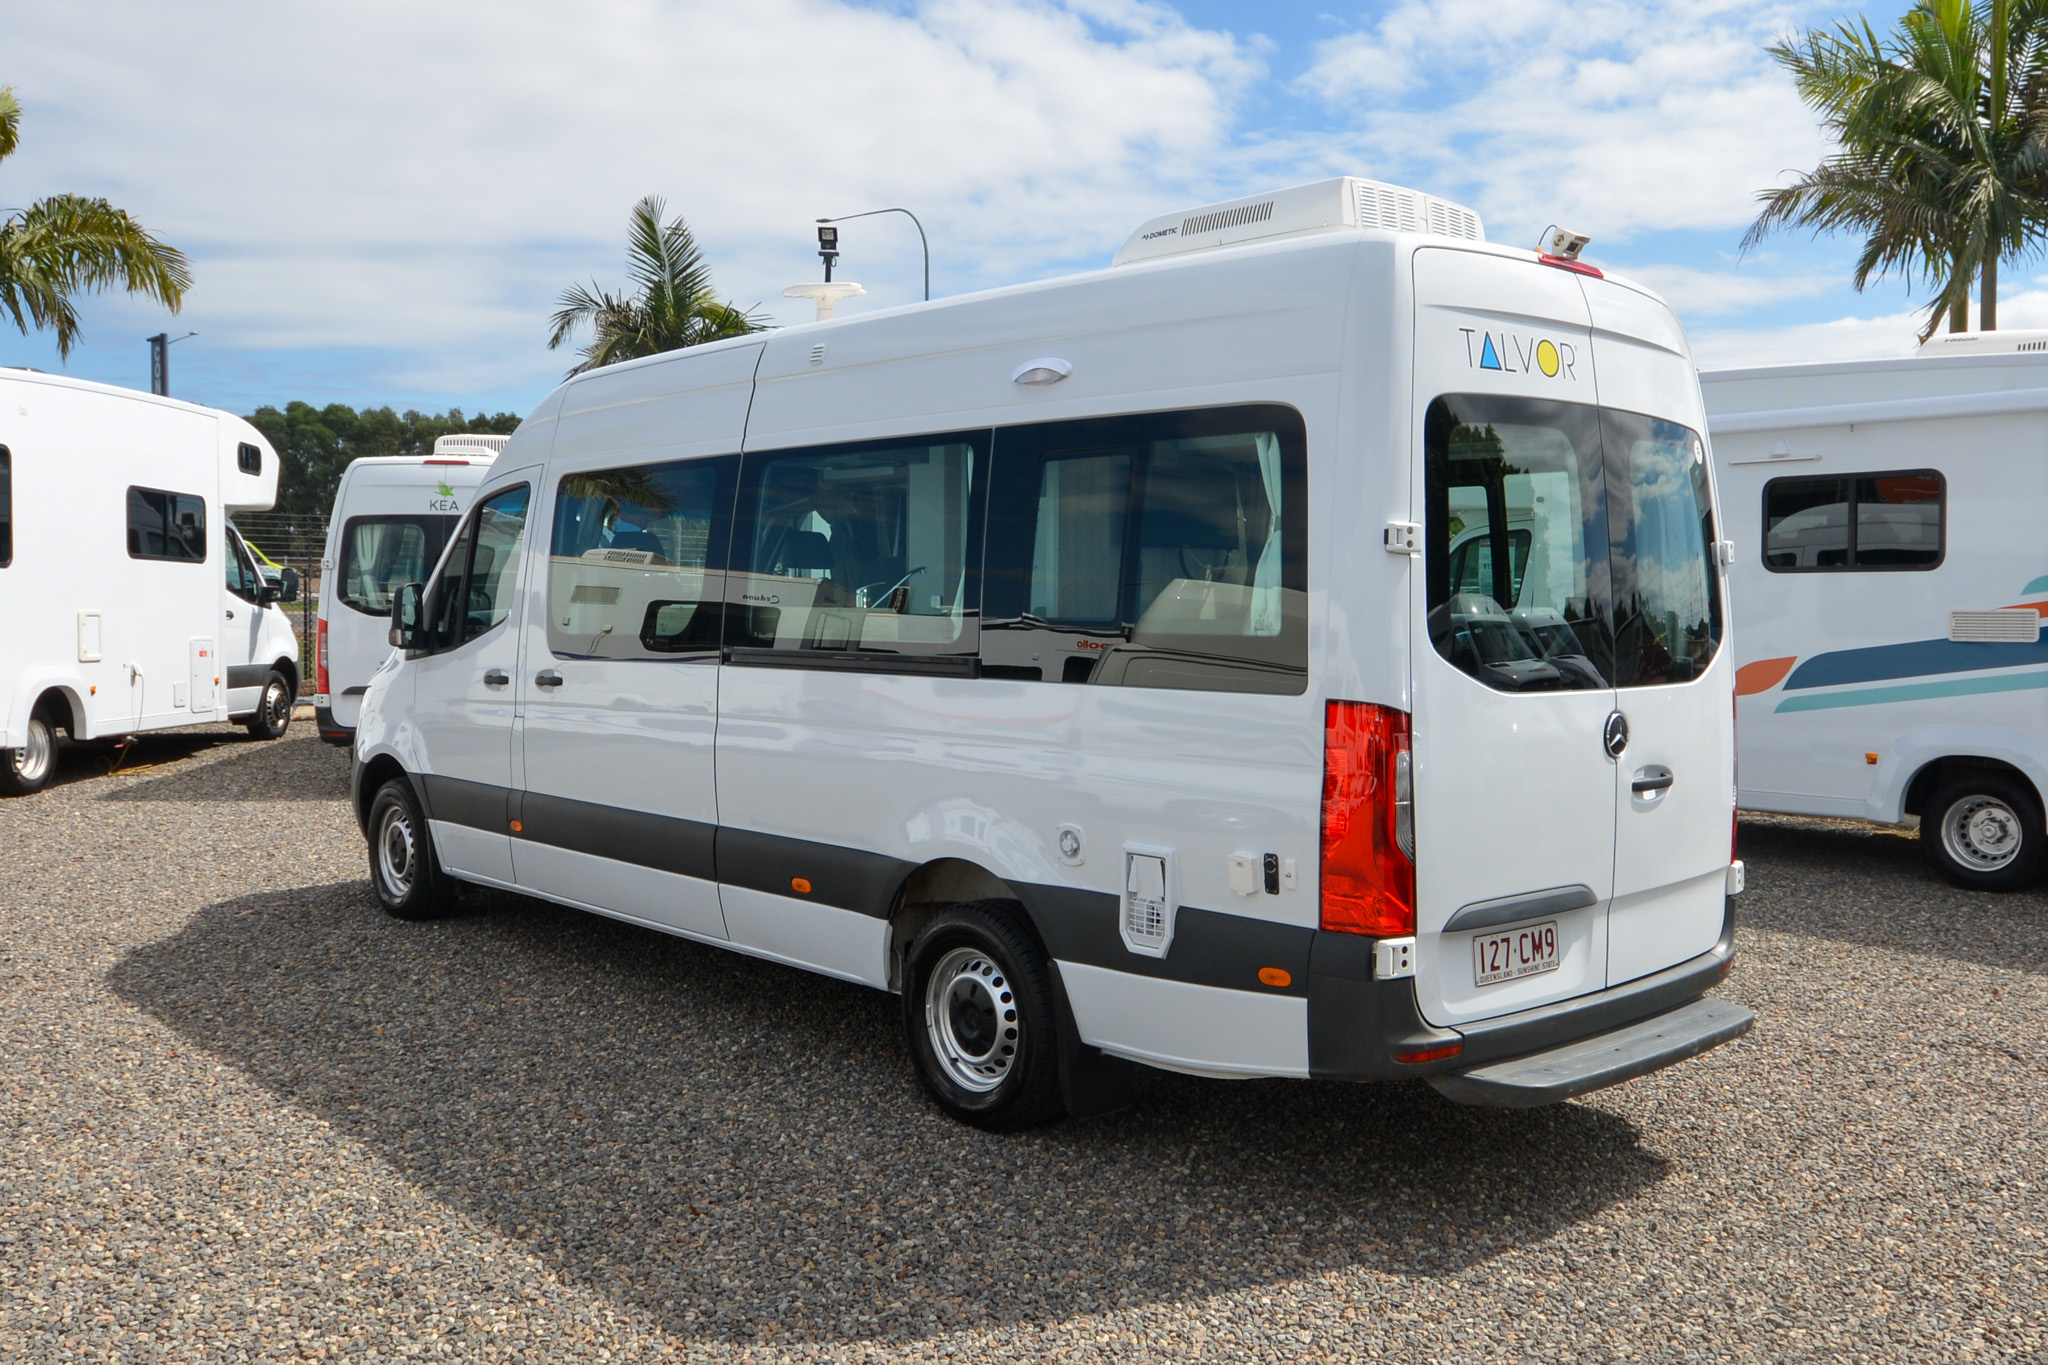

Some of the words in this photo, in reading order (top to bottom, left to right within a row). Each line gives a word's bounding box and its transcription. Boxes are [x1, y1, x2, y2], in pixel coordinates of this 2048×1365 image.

[1149, 226, 1179, 240] DOMETIC
[1458, 327, 1577, 382] TALVOR
[429, 499, 460, 512] KEA
[1480, 970, 1513, 984] QUEENSLAND
[1517, 964, 1541, 976] SUNSHINE
